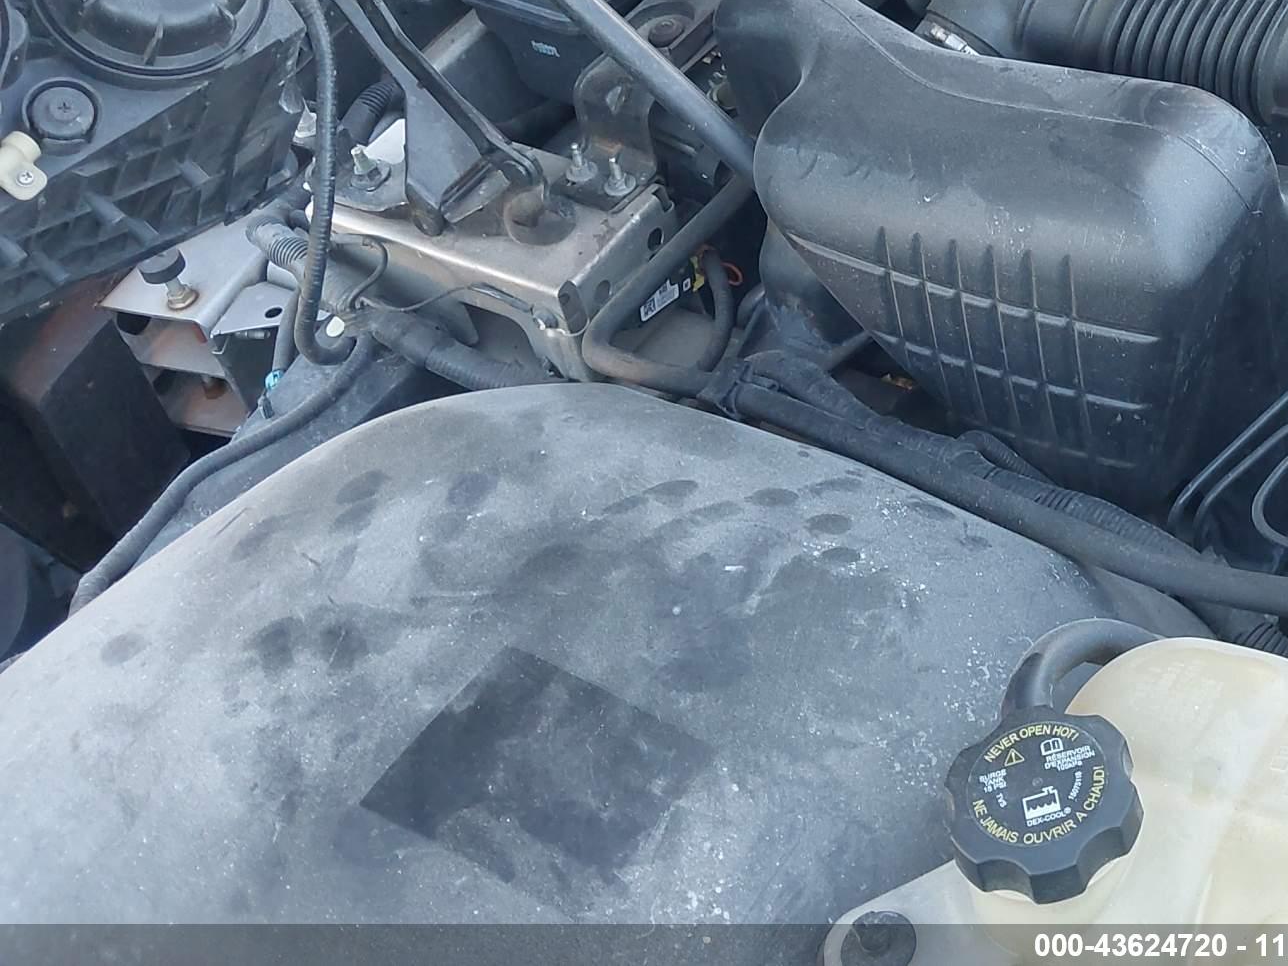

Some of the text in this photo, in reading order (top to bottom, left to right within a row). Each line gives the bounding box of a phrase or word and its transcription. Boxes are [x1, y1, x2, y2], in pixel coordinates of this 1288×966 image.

[984, 724, 1080, 763] NEVER OPEN HOT!
[979, 768, 1007, 783] SURGE
[983, 776, 1005, 787] TANK
[972, 799, 988, 818] NE
[980, 816, 1019, 844] JAMAIS
[1023, 819, 1077, 844] OUVRIR
[1083, 765, 1105, 811] CHAUD!
